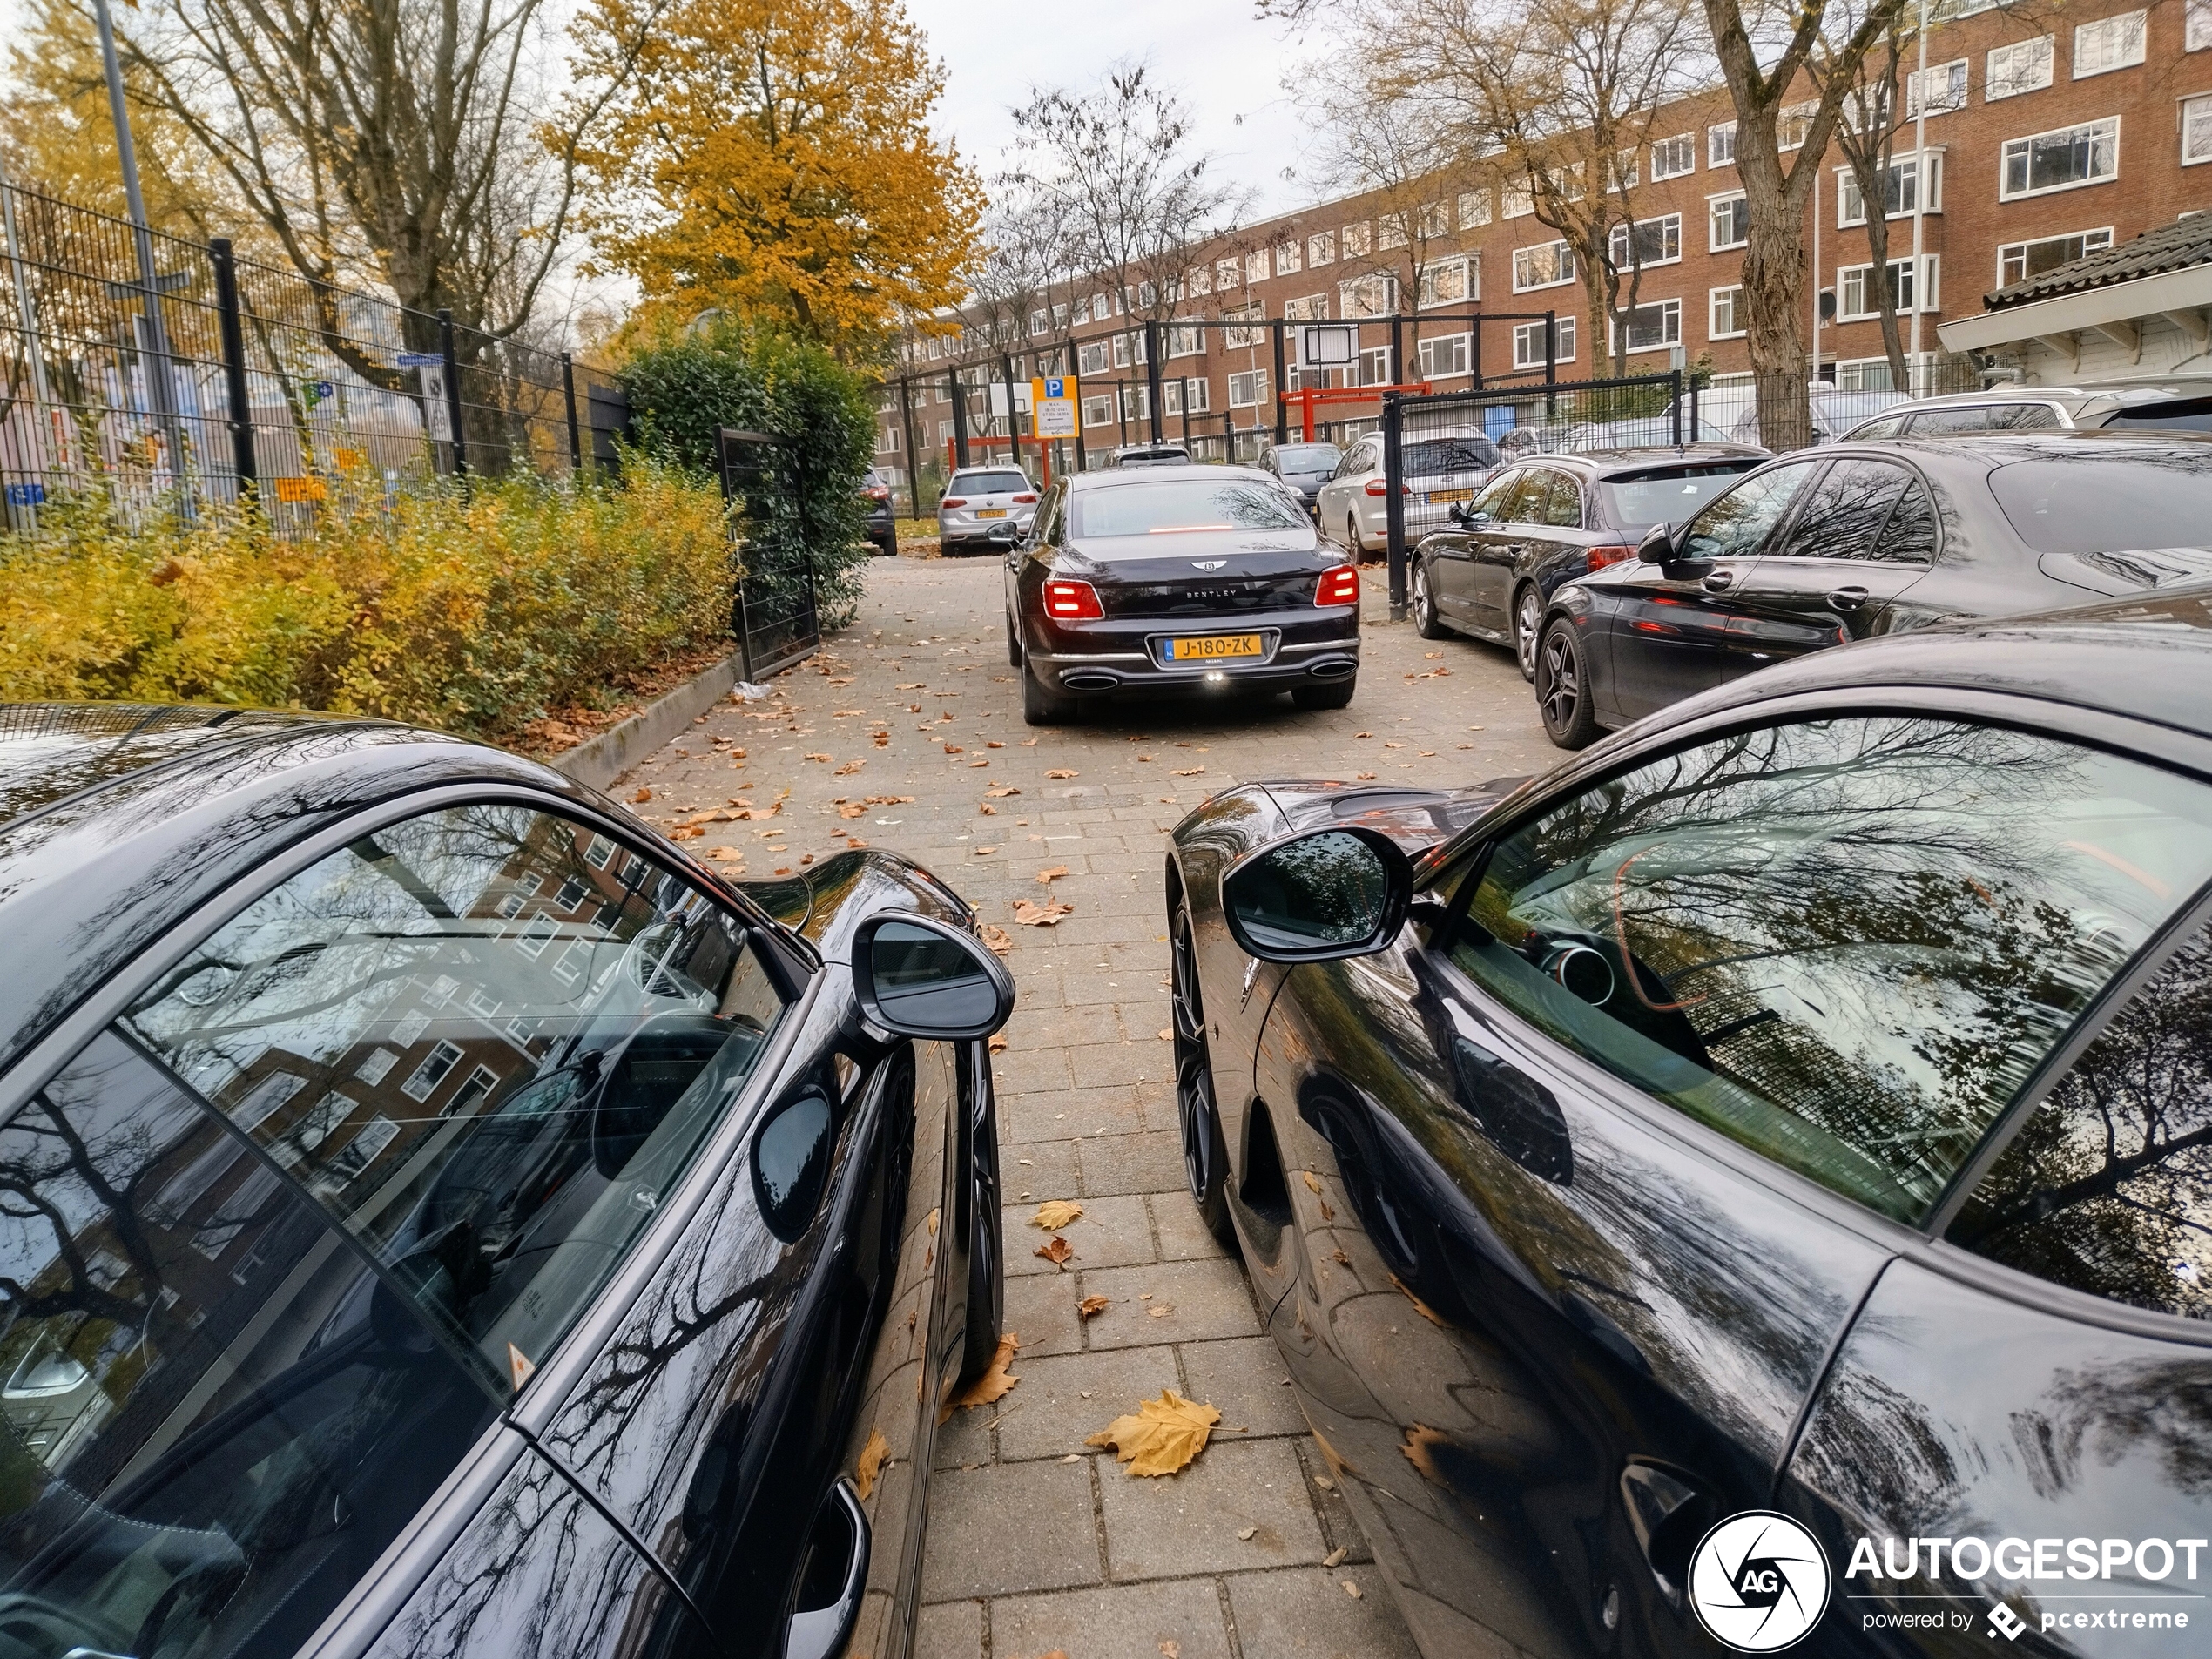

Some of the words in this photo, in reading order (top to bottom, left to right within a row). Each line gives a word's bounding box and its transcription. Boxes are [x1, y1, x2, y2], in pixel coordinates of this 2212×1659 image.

[1049, 381, 1061, 396] P
[1186, 590, 1237, 598] BENTLEY
[1183, 637, 1252, 656] J-180-ZK
